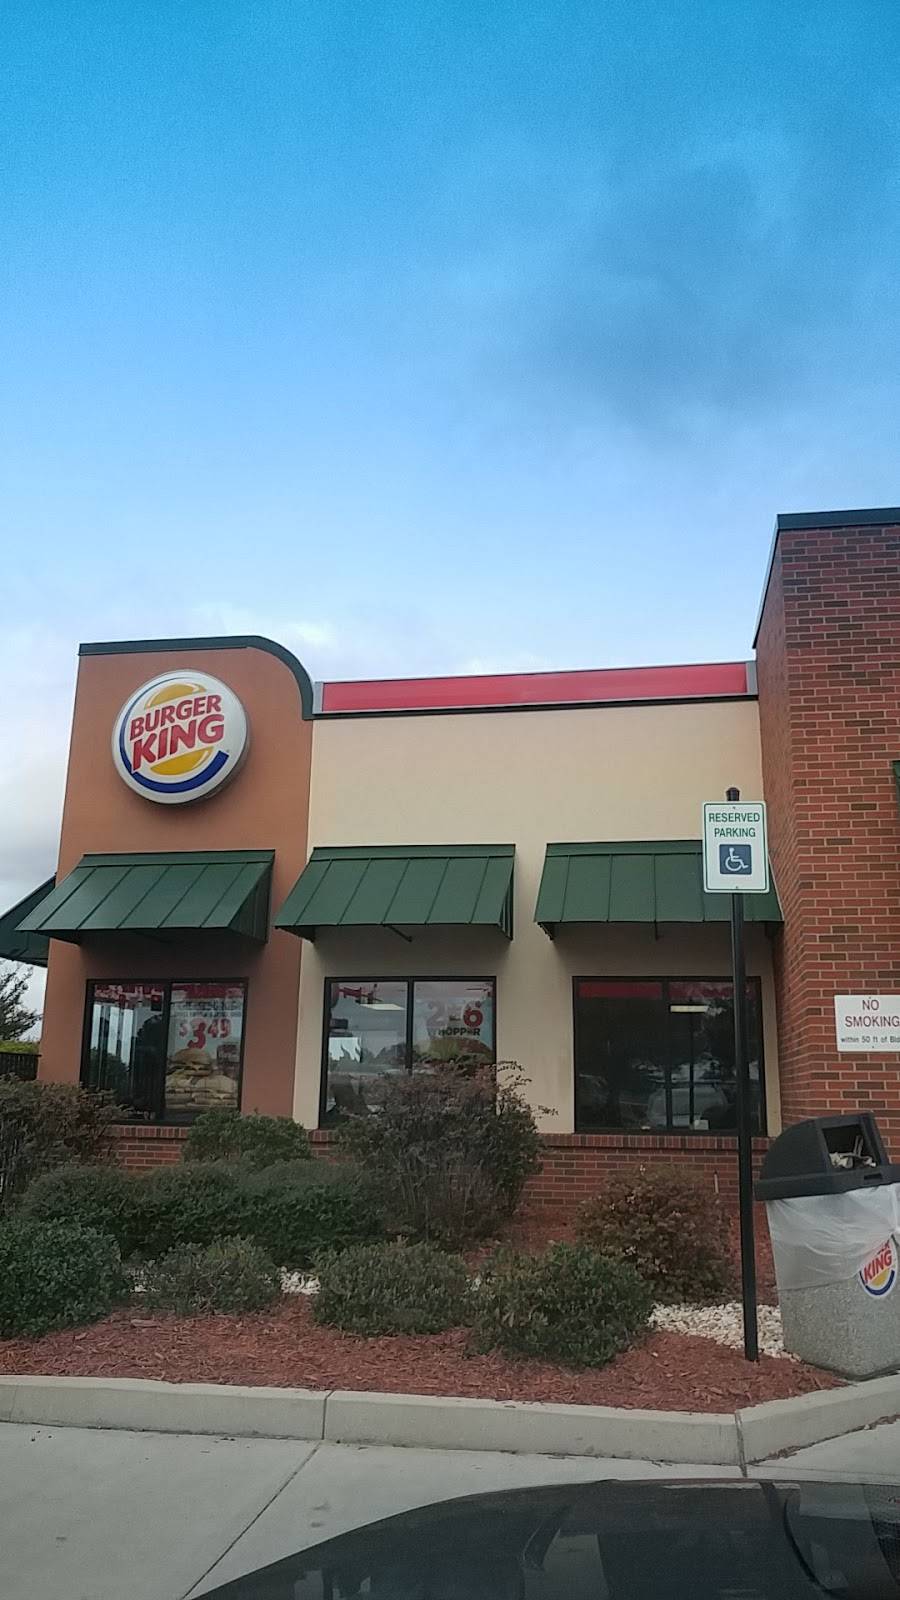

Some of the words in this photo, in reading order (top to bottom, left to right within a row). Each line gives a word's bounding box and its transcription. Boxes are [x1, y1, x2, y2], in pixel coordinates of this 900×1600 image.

[130, 694, 222, 741] BURGER
[132, 714, 225, 771] KING
[708, 812, 761, 822] RESERVED
[714, 827, 756, 838] PARKING
[862, 999, 880, 1011] NO
[844, 1015, 900, 1028] SMOKING
[861, 1035, 871, 1043] 50
[872, 1035, 879, 1043] ft
[863, 1249, 892, 1285] KING
